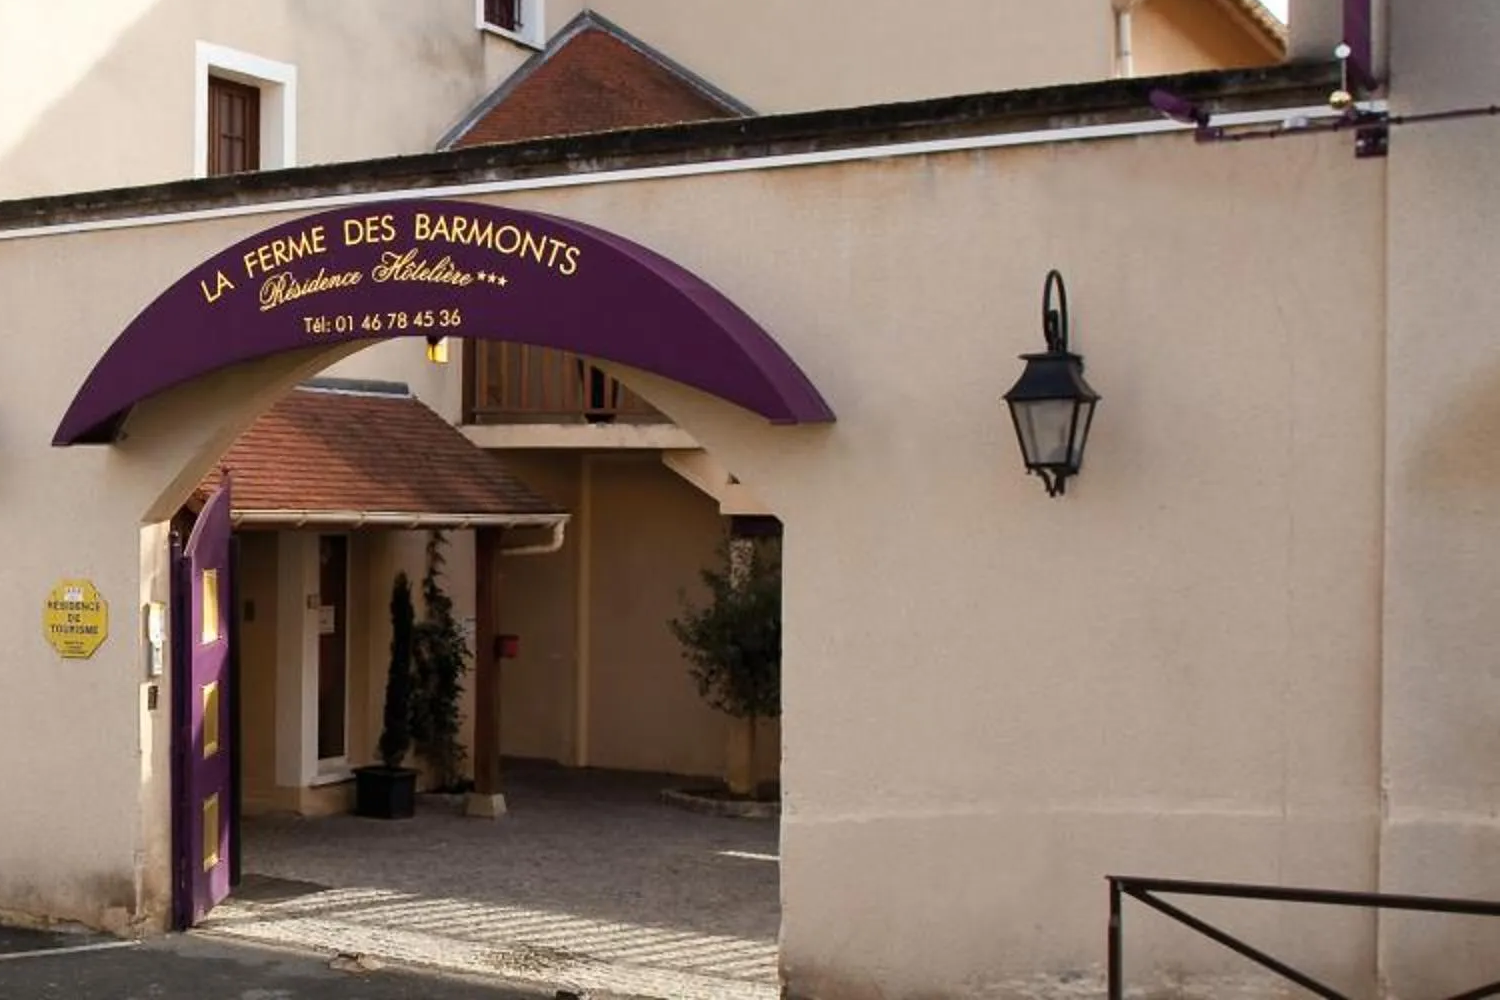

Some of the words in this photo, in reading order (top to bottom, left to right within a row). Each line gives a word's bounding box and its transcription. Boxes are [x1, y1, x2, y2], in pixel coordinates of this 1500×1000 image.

[200, 270, 235, 303] LA
[243, 226, 328, 279] FERME
[343, 215, 396, 246] DES
[414, 213, 581, 276] BARMONTS
[258, 267, 364, 312] Résidence
[371, 247, 475, 287] Hôtelière
[335, 315, 353, 333] 01
[361, 314, 382, 332] 46
[387, 311, 408, 330] 78
[413, 310, 435, 328] 45
[439, 308, 461, 326] 36
